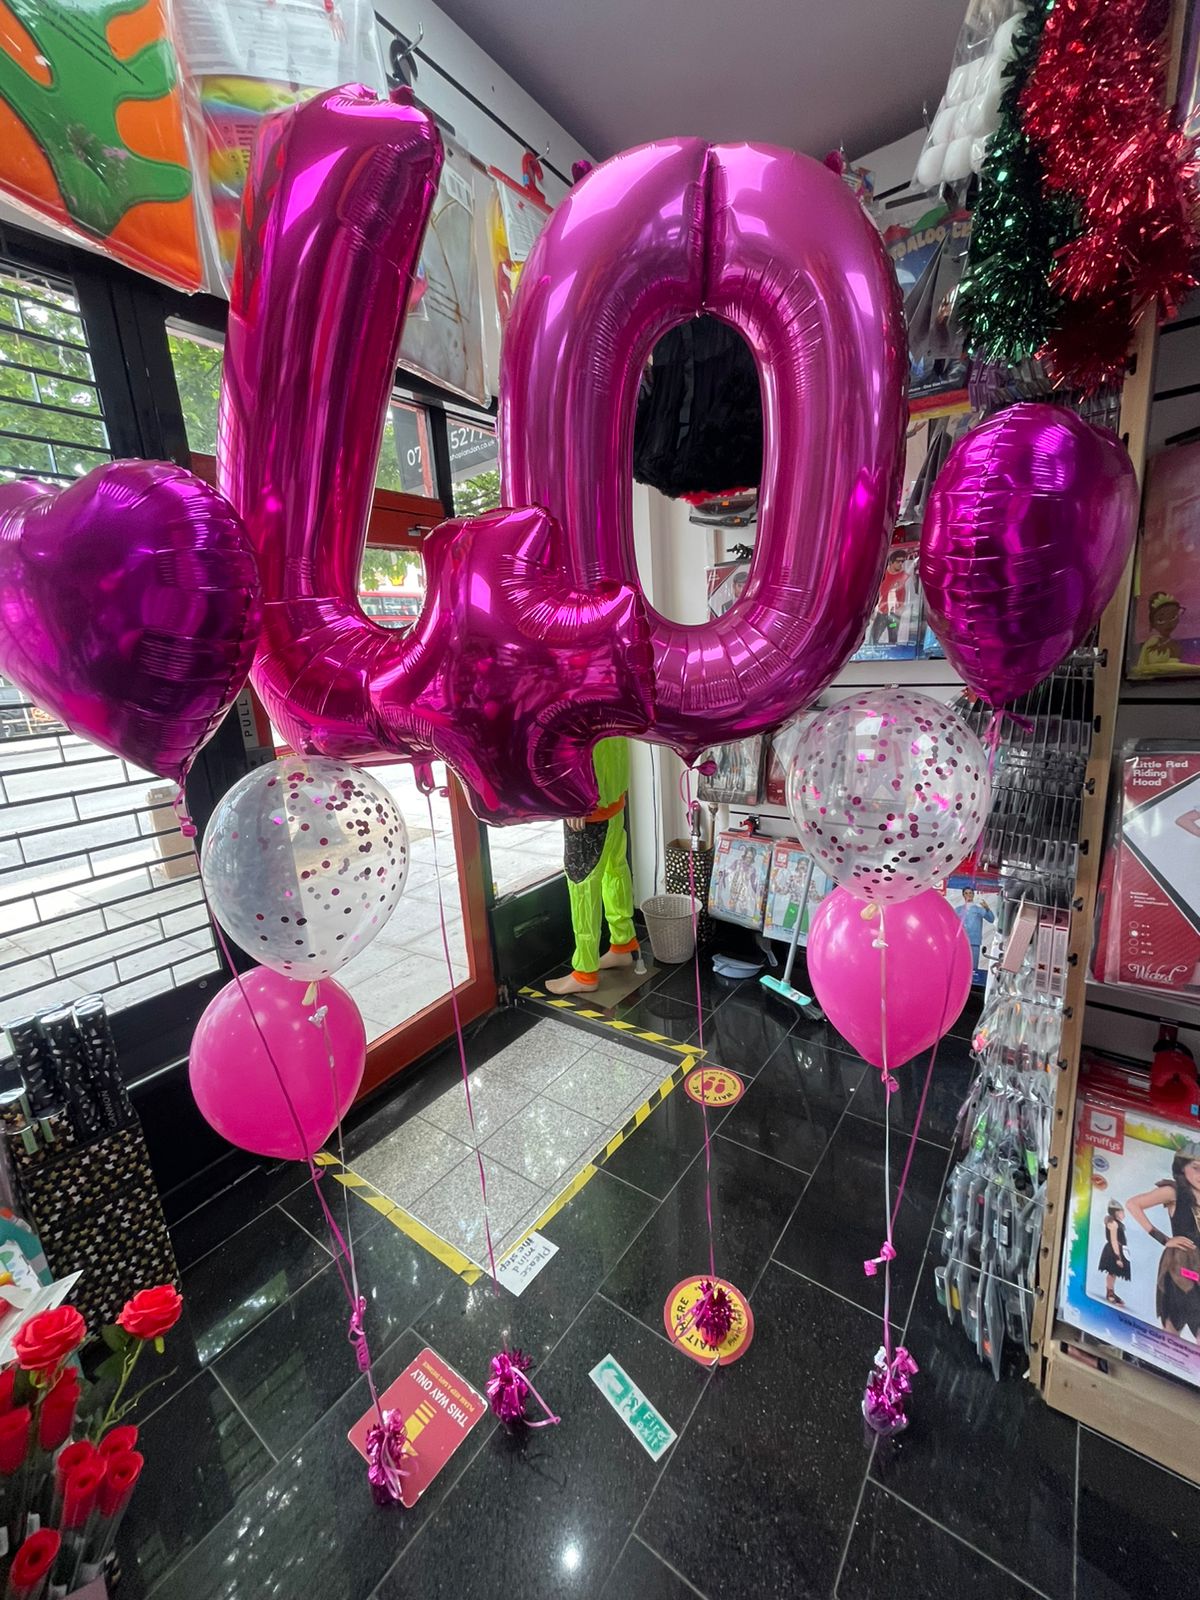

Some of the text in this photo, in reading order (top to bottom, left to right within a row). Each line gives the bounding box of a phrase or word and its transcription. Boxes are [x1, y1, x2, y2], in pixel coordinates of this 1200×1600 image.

[240, 700, 253, 737] PULL
[1132, 760, 1189, 769] Little Red
[1132, 769, 1168, 779] Riding
[1132, 778, 1162, 786] Hood
[1084, 1133, 1121, 1151] smiffys
[410, 1369, 469, 1428] THIS WAY ONLY
[636, 1421, 659, 1448] exit
[643, 1411, 669, 1440] Fire
